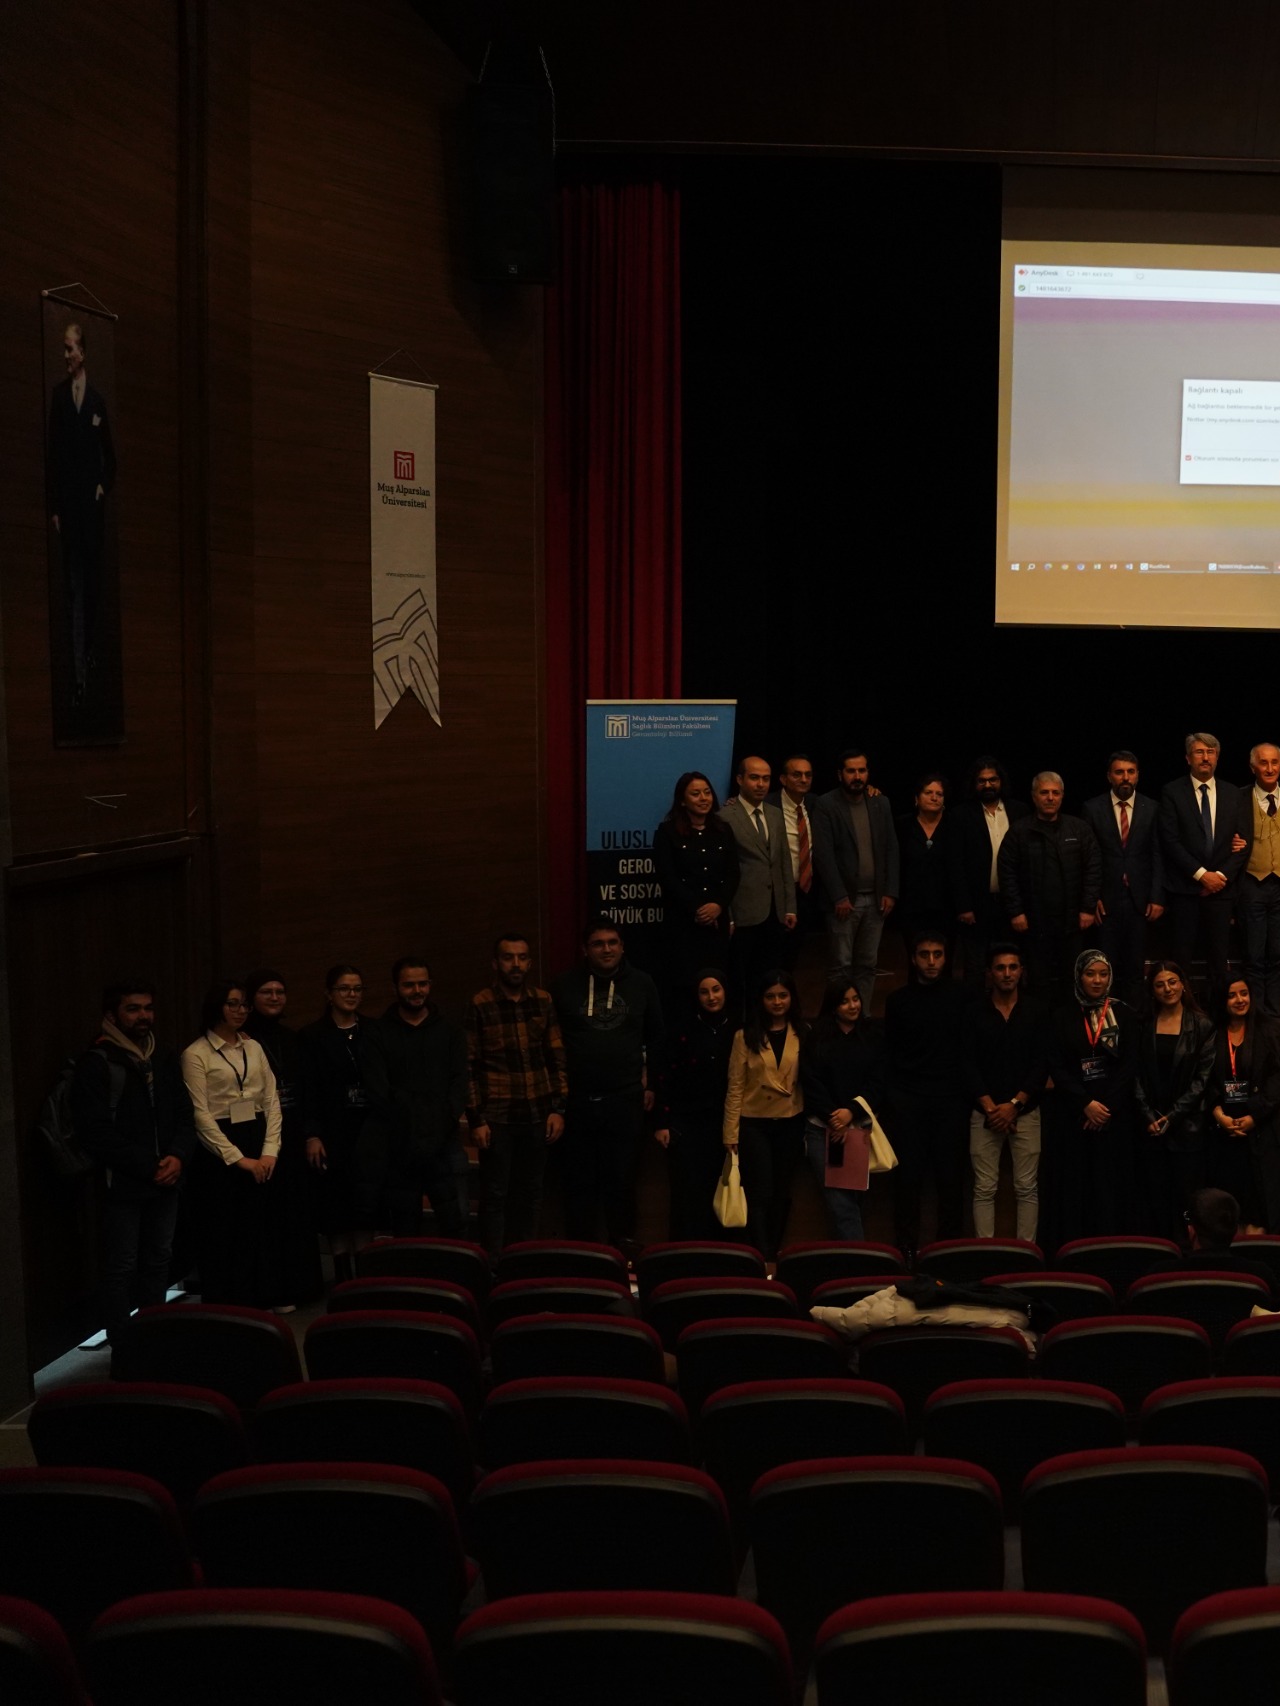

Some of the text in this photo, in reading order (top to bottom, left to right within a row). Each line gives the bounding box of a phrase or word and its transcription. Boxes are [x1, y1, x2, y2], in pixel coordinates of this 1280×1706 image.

[1031, 270, 1058, 278] AnyDesk
[1188, 386, 1243, 396] Bağlantı kapalı
[377, 482, 431, 497] Muş Alparslan
[381, 494, 427, 509] Üniversitesi
[679, 713, 719, 721] Üniversitesi
[619, 858, 656, 875] GERO
[600, 884, 617, 901] VE
